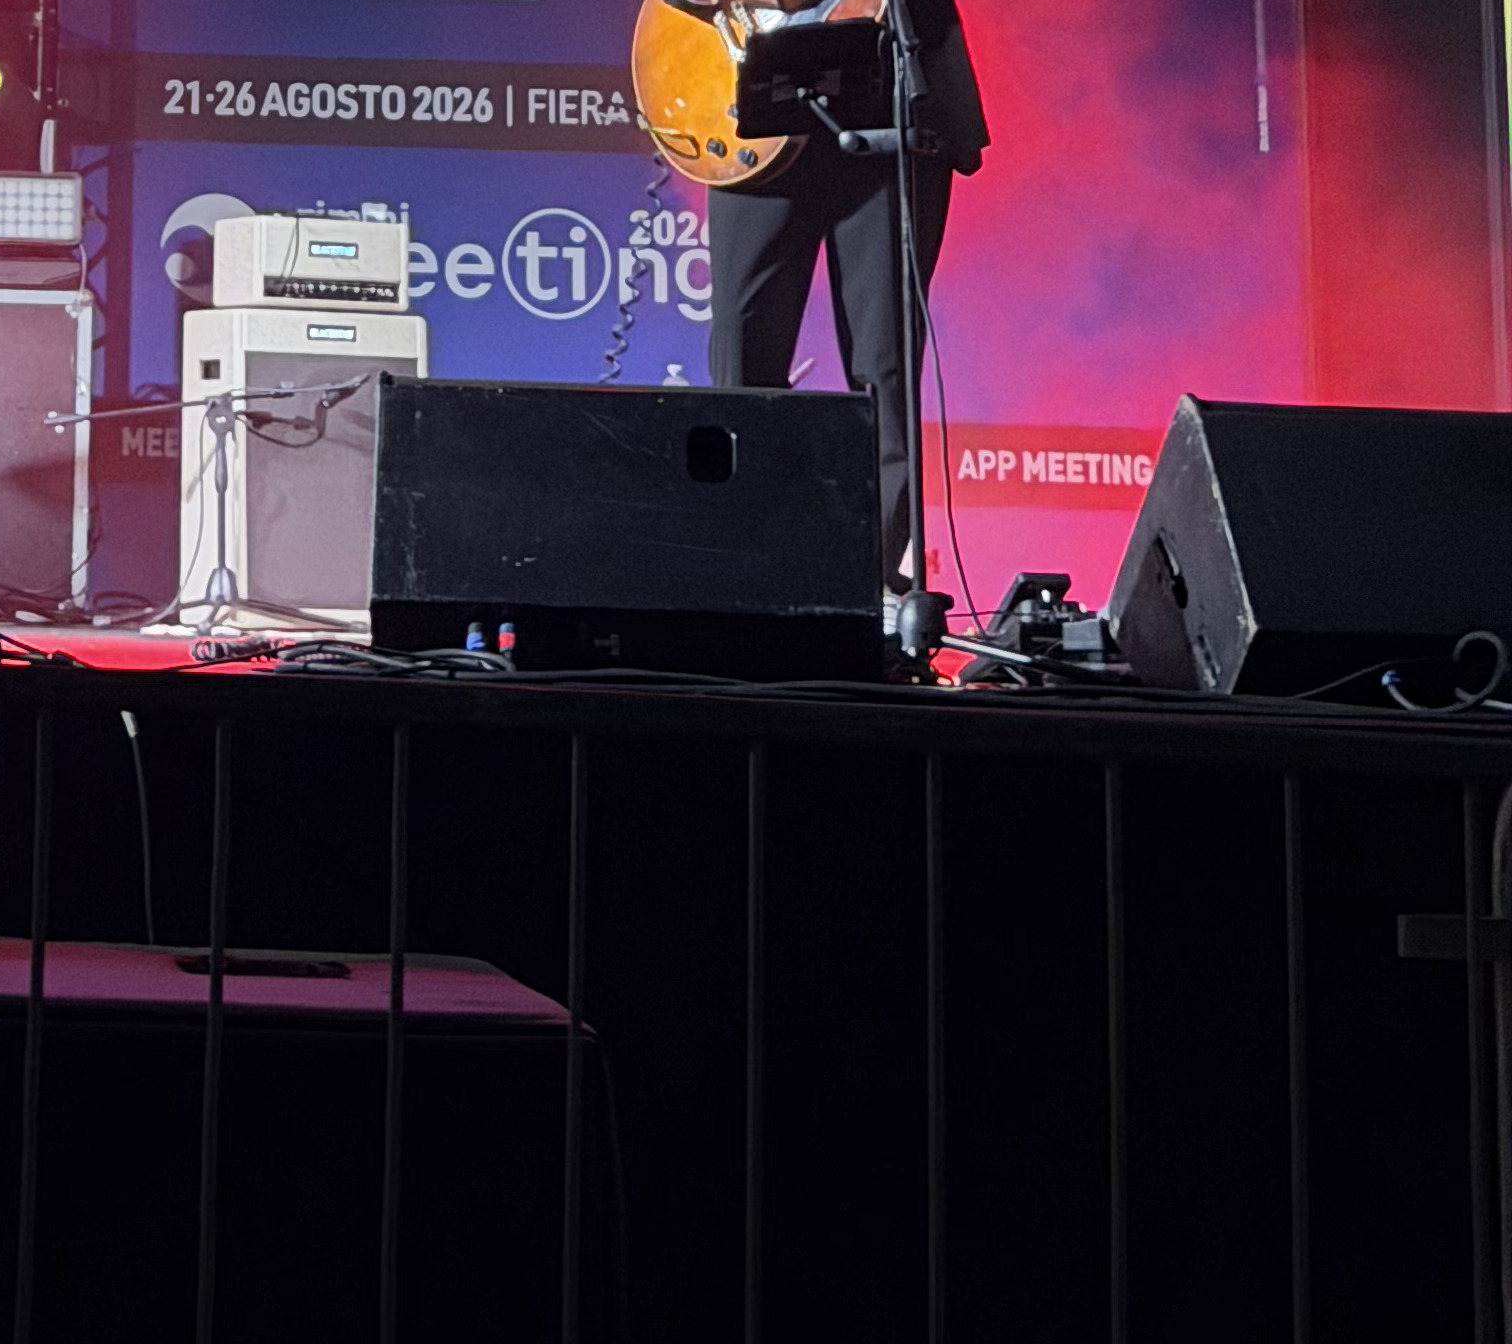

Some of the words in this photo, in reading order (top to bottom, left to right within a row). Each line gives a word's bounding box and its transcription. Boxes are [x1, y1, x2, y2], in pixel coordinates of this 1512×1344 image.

[260, 81, 405, 122] AGOSTO
[411, 86, 494, 123] 2026
[527, 88, 631, 126] FIERA
[957, 448, 1017, 481] APP
[1022, 450, 1154, 486] MEETING
